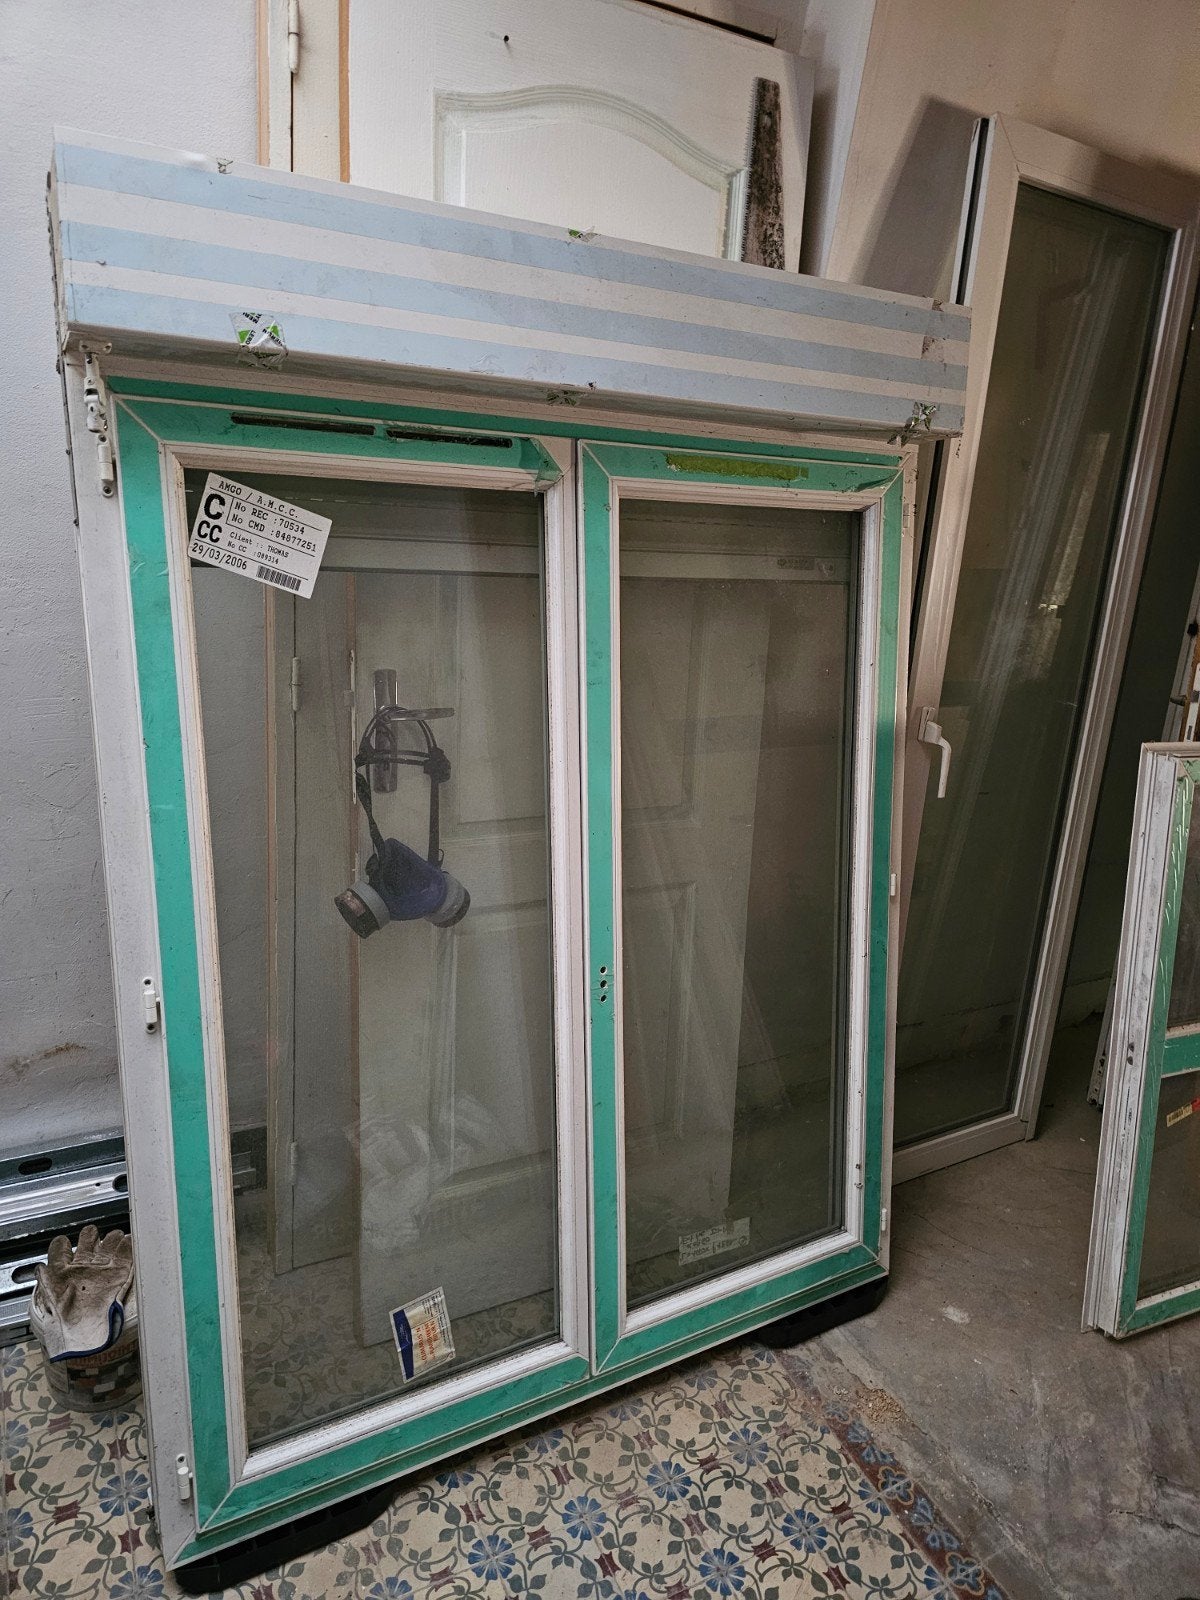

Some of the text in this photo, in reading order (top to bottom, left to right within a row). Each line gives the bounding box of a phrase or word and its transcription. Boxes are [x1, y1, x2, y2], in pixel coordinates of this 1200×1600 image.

[203, 493, 226, 521] C
[218, 480, 299, 518] AMGO / A.M.C.C.
[234, 502, 246, 513] No
[251, 507, 269, 521] REC
[197, 520, 223, 543] CC
[231, 513, 243, 524] No
[248, 519, 265, 532] CMD
[191, 542, 248, 570] 29/03/2006
[227, 541, 236, 549] No
[238, 545, 248, 553] CC
[229, 531, 253, 545] Client
[267, 545, 290, 559] THOMAS
